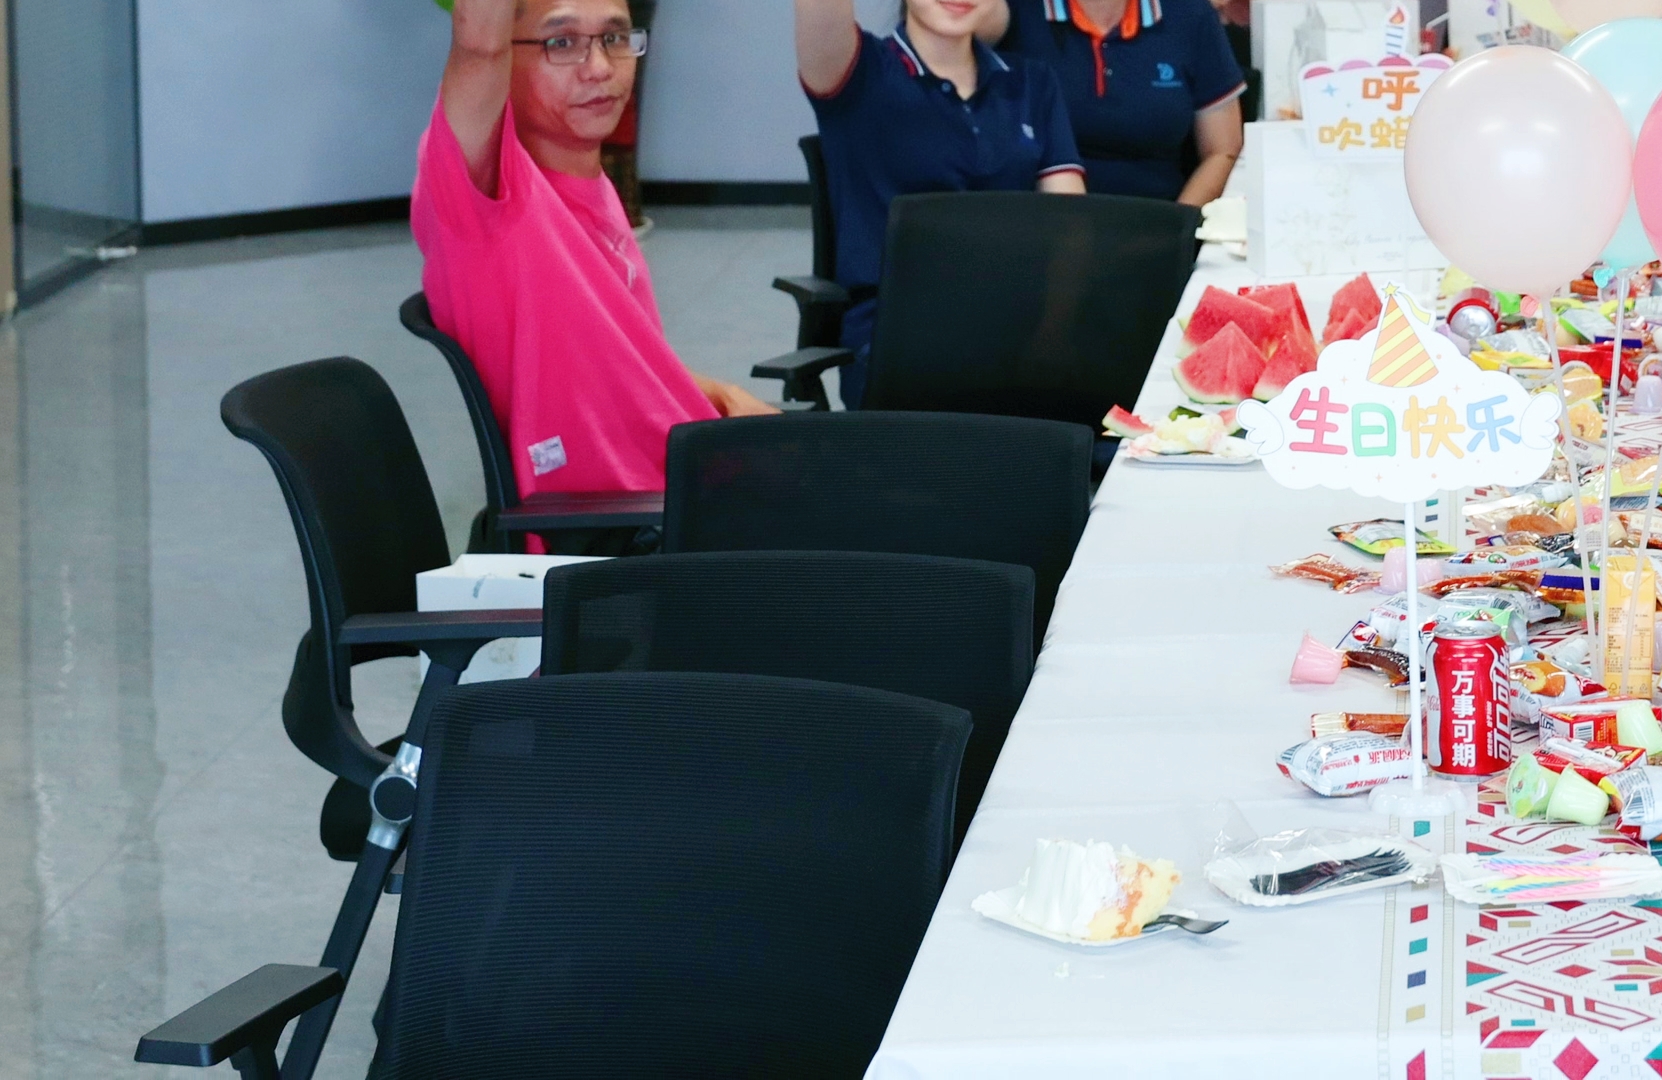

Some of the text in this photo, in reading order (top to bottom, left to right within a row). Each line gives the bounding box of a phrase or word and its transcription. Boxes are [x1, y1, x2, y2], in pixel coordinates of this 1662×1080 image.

[1362, 70, 1420, 111] 呼
[1288, 386, 1521, 459] 生日快乐
[1451, 670, 1476, 768] 万事可期
